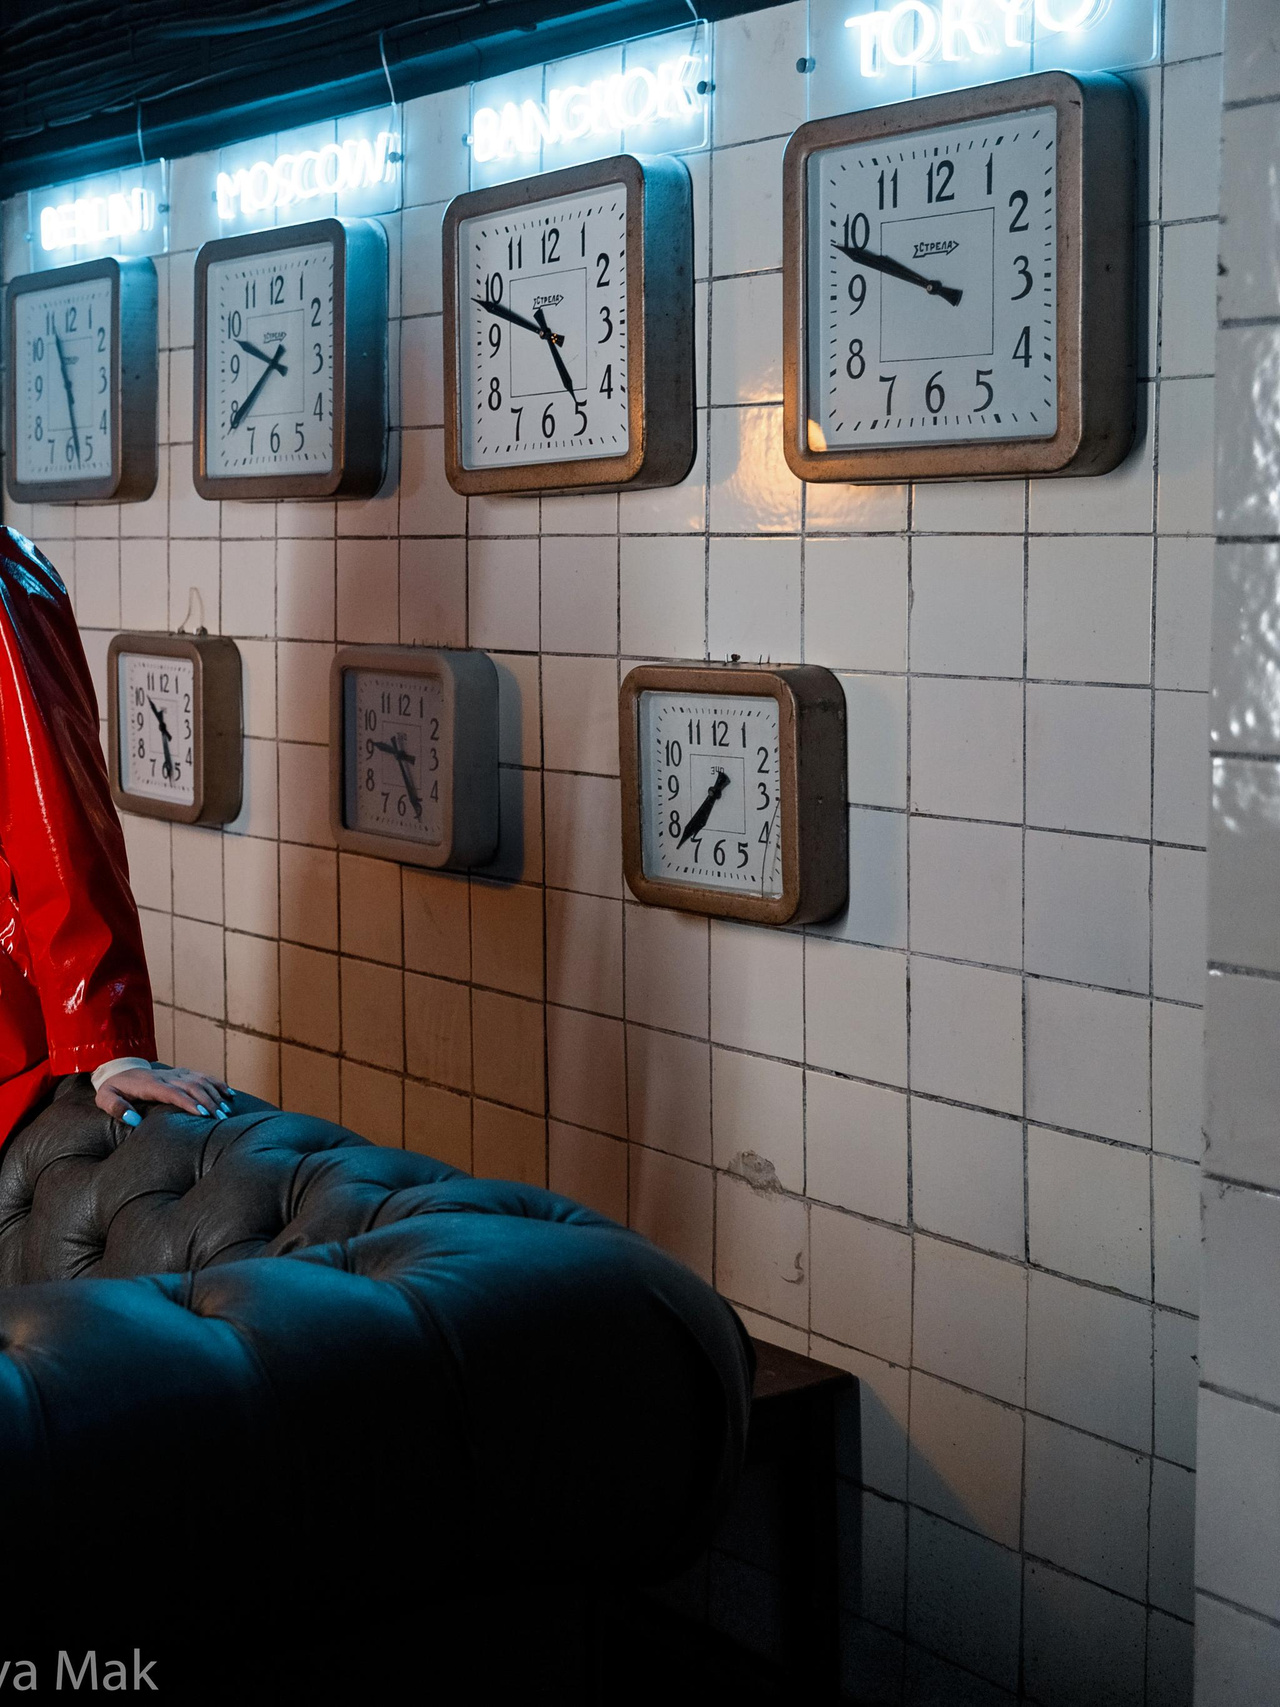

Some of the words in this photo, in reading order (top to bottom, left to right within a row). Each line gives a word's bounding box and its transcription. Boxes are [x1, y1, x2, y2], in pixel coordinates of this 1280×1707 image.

[472, 55, 700, 163] BANGKOK
[216, 132, 394, 219] MOSCOW
[877, 168, 898, 210] 11
[926, 160, 955, 204] 12
[985, 152, 993, 195] 1
[40, 187, 152, 251] BERLIN
[1008, 189, 1029, 233] 2
[842, 212, 870, 250] 10
[508, 234, 522, 270] 11
[541, 228, 561, 264] 12
[580, 221, 586, 257] 1
[919, 241, 953, 253] СТРЕЛА
[596, 252, 610, 288] 2
[1010, 255, 1033, 301] 3
[245, 280, 256, 309] 11
[270, 275, 284, 305] 12
[299, 271, 304, 301] 1
[484, 272, 503, 304] 10
[848, 274, 866, 316] 9
[46, 310, 56, 336] 11
[65, 307, 77, 333] 12
[88, 304, 92, 330] 1
[227, 310, 242, 339] 10
[310, 297, 322, 327] 2
[598, 306, 613, 344] 3
[33, 337, 44, 363] 10
[97, 327, 106, 353] 2
[489, 323, 501, 358] 9
[1012, 325, 1032, 368] 4
[231, 354, 240, 384] 9
[312, 343, 324, 375] 3
[846, 338, 866, 380] 8
[35, 375, 43, 401] 9
[98, 366, 107, 394] 3
[488, 377, 502, 411] 8
[599, 364, 613, 400] 4
[879, 375, 897, 416] 7
[925, 370, 945, 414] 6
[973, 369, 994, 412] 5
[313, 392, 324, 422] 4
[510, 406, 524, 441] 7
[541, 402, 556, 439] 6
[573, 399, 588, 437] 5
[34, 416, 43, 441] 8
[99, 409, 107, 435] 4
[48, 439, 55, 464] 7
[65, 436, 75, 463] 6
[85, 436, 93, 462] 5
[247, 427, 256, 455] 7
[270, 423, 280, 453] 6
[294, 422, 305, 453] 5
[135, 687, 145, 706] 10
[147, 672, 155, 691] 11
[160, 673, 170, 693] 12
[175, 675, 179, 694] 1
[184, 693, 191, 713] 2
[381, 691, 390, 714] 11
[399, 694, 411, 717] 12
[420, 696, 424, 718] 1
[137, 712, 144, 731] 9
[184, 719, 191, 740] 3
[364, 708, 376, 731] 10
[430, 717, 440, 741] 2
[687, 718, 701, 745] 11
[711, 720, 730, 747] 12
[741, 722, 746, 748] 1
[138, 738, 145, 759] 8
[185, 747, 192, 766] 4
[366, 738, 374, 760] 9
[429, 748, 439, 771] 3
[665, 740, 682, 767] 10
[757, 746, 770, 774] 2
[149, 758, 156, 777] 7
[174, 762, 181, 781] 5
[365, 768, 375, 791] 8
[430, 780, 439, 803] 4
[668, 774, 680, 801] 9
[756, 782, 770, 810] 3
[381, 792, 390, 813] 7
[398, 794, 407, 817] 6
[668, 810, 681, 838] 8
[758, 821, 771, 846] 4
[691, 837, 702, 863] 7
[713, 839, 726, 866] 6
[737, 842, 749, 869] 5
